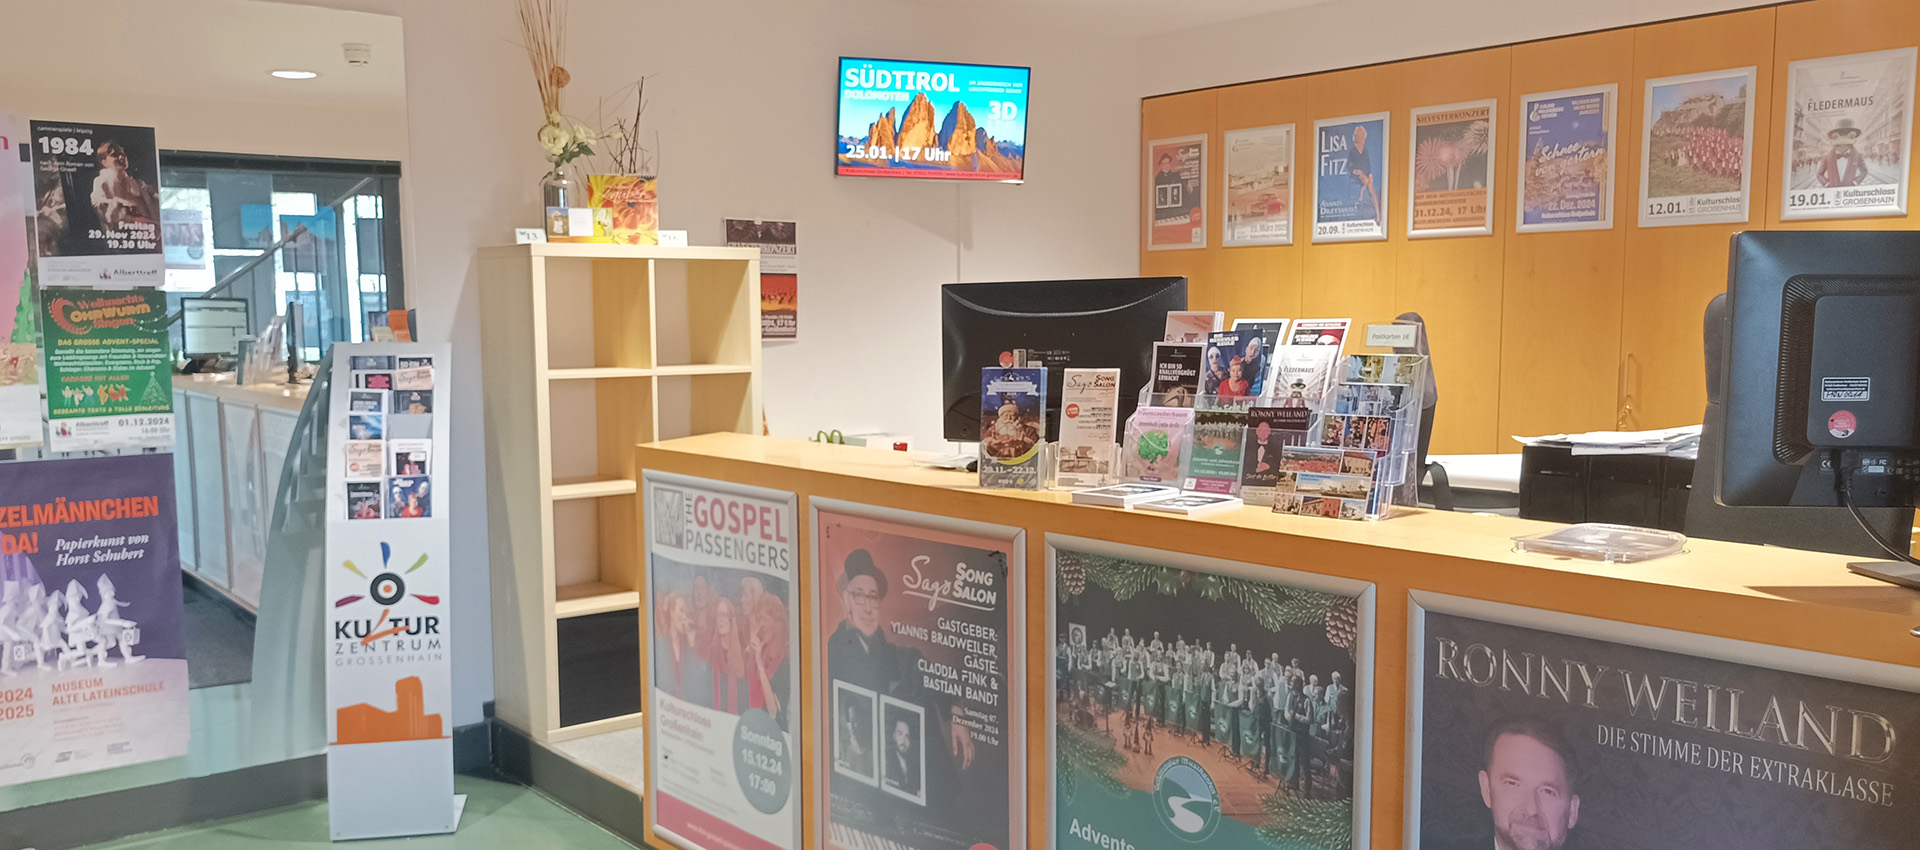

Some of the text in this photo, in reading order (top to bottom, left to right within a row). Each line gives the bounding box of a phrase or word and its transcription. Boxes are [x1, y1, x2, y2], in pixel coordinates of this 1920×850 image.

[844, 63, 960, 93] SÜDTIROL
[988, 100, 1017, 121] 3D
[1807, 96, 1875, 112] FLEDERMAUS
[1417, 109, 1490, 124] SILVESTERKONZERT
[39, 136, 94, 156] 1984
[902, 147, 921, 161] 17
[924, 147, 952, 162] Uhr
[1539, 142, 1581, 164] Schnee
[1789, 193, 1831, 207] 19.01.
[1843, 188, 1896, 198] Kulturschloss
[1648, 201, 1686, 215] 12.01.
[118, 221, 155, 233] Freitag
[130, 230, 156, 240] 2024
[1318, 225, 1340, 236] 20.09.
[107, 239, 157, 249] 19.30 Uhr
[118, 417, 170, 427] 01.12.2024
[1251, 410, 1275, 418] RONNY
[684, 492, 693, 526] THE
[694, 495, 788, 543] GOSPEL
[1, 532, 39, 555] DA!
[55, 534, 150, 553] Papierkunst von
[685, 530, 789, 571] PASSENGERS
[56, 549, 145, 567] Horst Schubert
[902, 555, 997, 611] Sago SALON
[956, 562, 994, 586] SONG
[335, 611, 441, 645] KULTUR
[891, 621, 929, 642] YIANNIS
[937, 617, 998, 642] GASTGEBER:
[335, 640, 442, 656] ZENTRUM
[335, 653, 443, 667] GROSSENHAIN
[917, 658, 998, 690] CLAUDIA FINK &
[52, 677, 103, 694] MUSEUM
[53, 681, 165, 706] ALTE LATEINSCHULE
[923, 675, 998, 706] BASTIAN BANDT
[1434, 636, 1897, 766] RONNY WEILAND
[660, 700, 712, 728] Kulturschloss
[952, 715, 984, 733] Dezember
[964, 706, 987, 722] Samstag
[660, 714, 704, 742] Großenhain
[740, 725, 783, 757] Sonntag
[987, 735, 999, 746] Uhr
[741, 748, 783, 776] 15.12.24
[1597, 724, 1895, 808] DIE STIMME DER EXTRAKLASSE
[748, 772, 776, 796] 17:00
